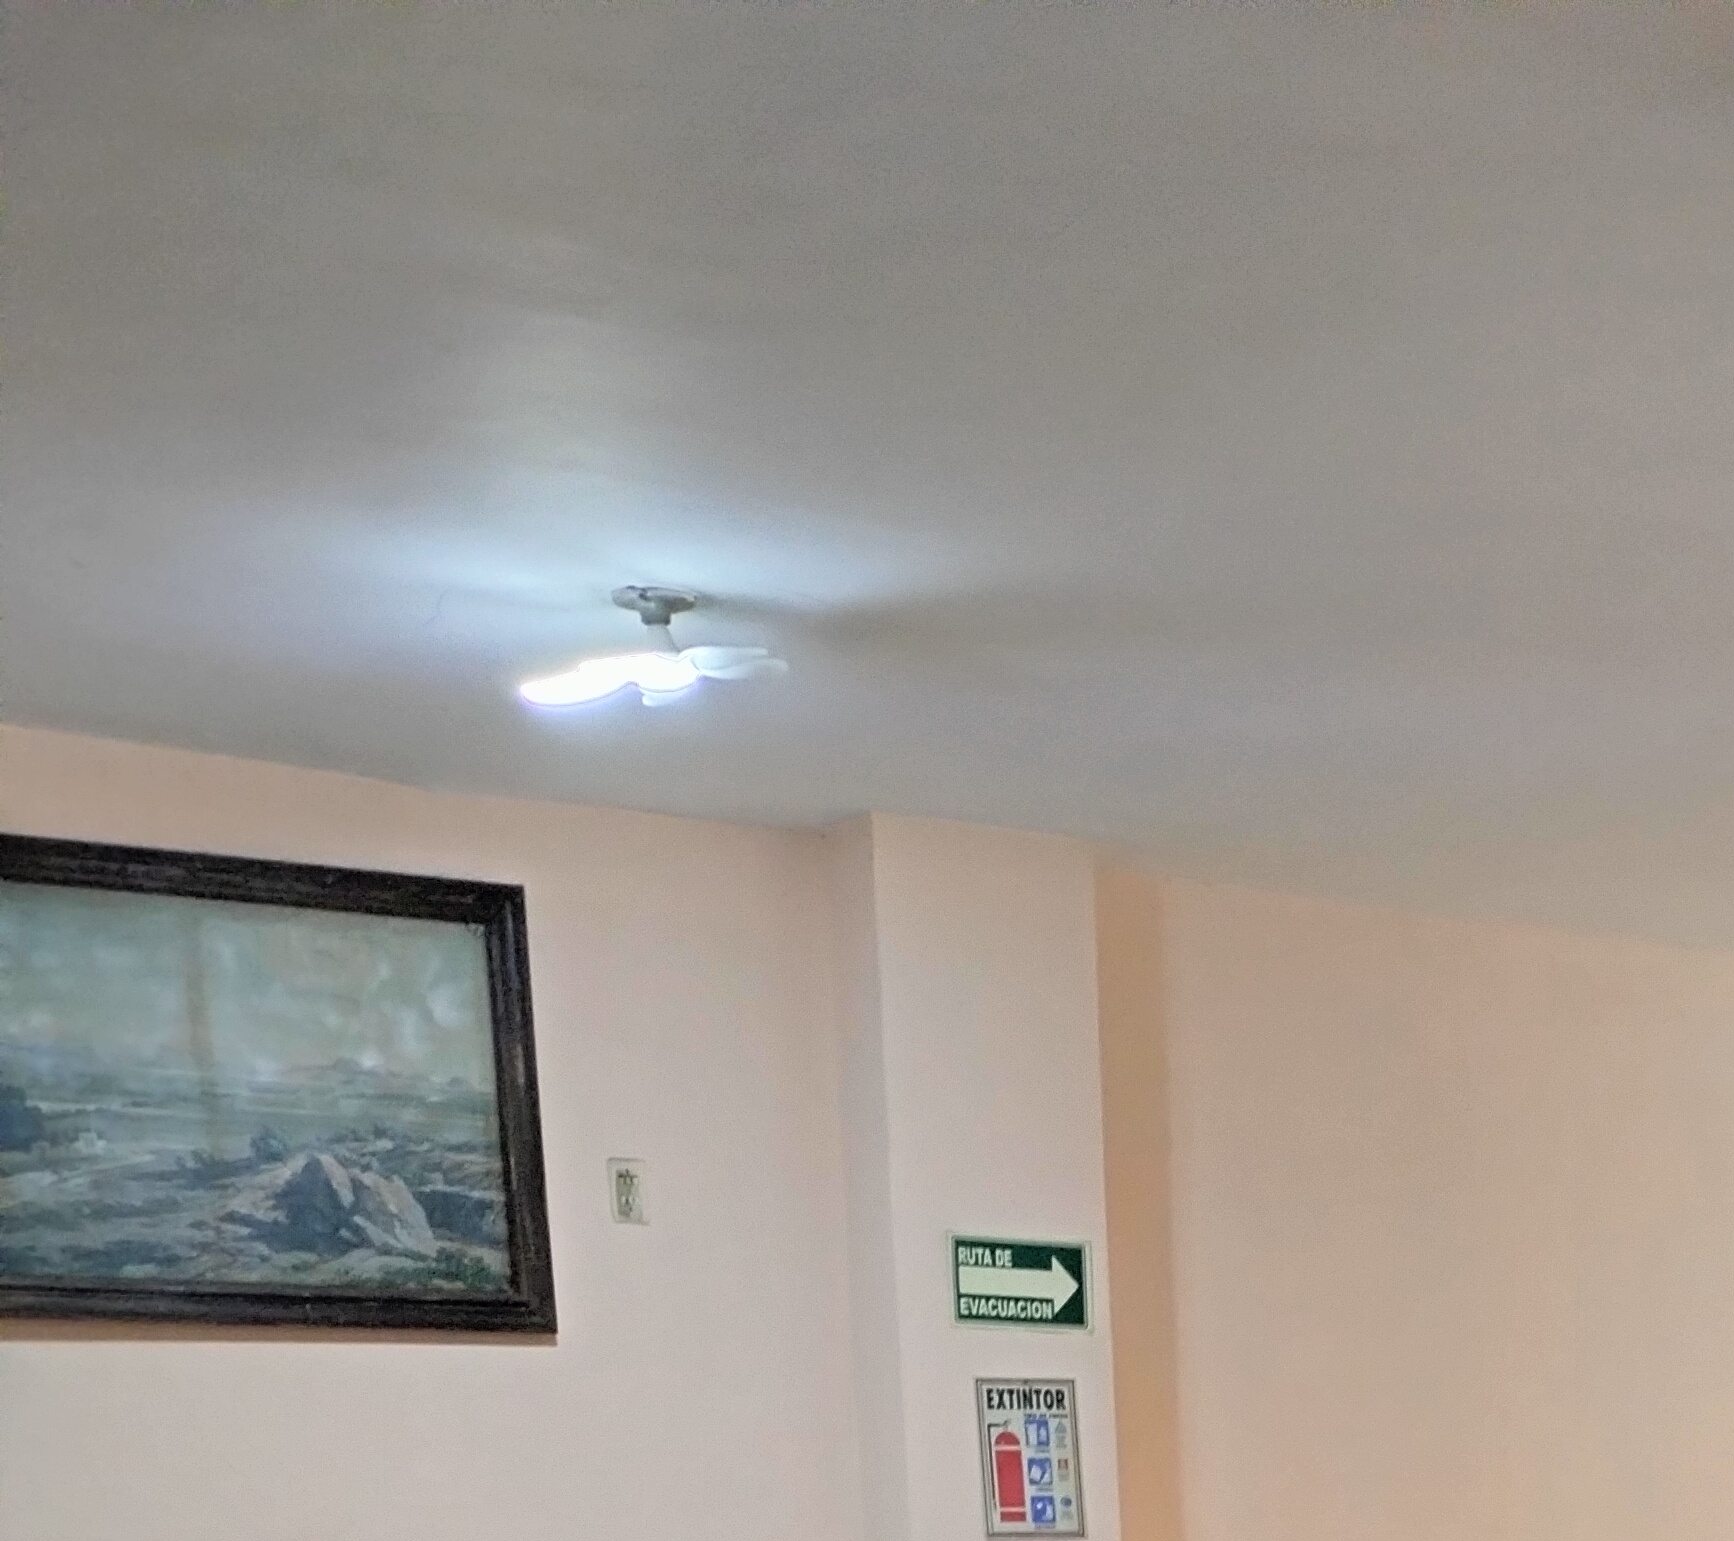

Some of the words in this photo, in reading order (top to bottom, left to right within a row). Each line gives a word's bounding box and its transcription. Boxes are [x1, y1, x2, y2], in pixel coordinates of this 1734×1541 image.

[958, 1246, 992, 1266] RUTA
[995, 1248, 1012, 1268] DE
[986, 1387, 1066, 1410] EXTINTOR
